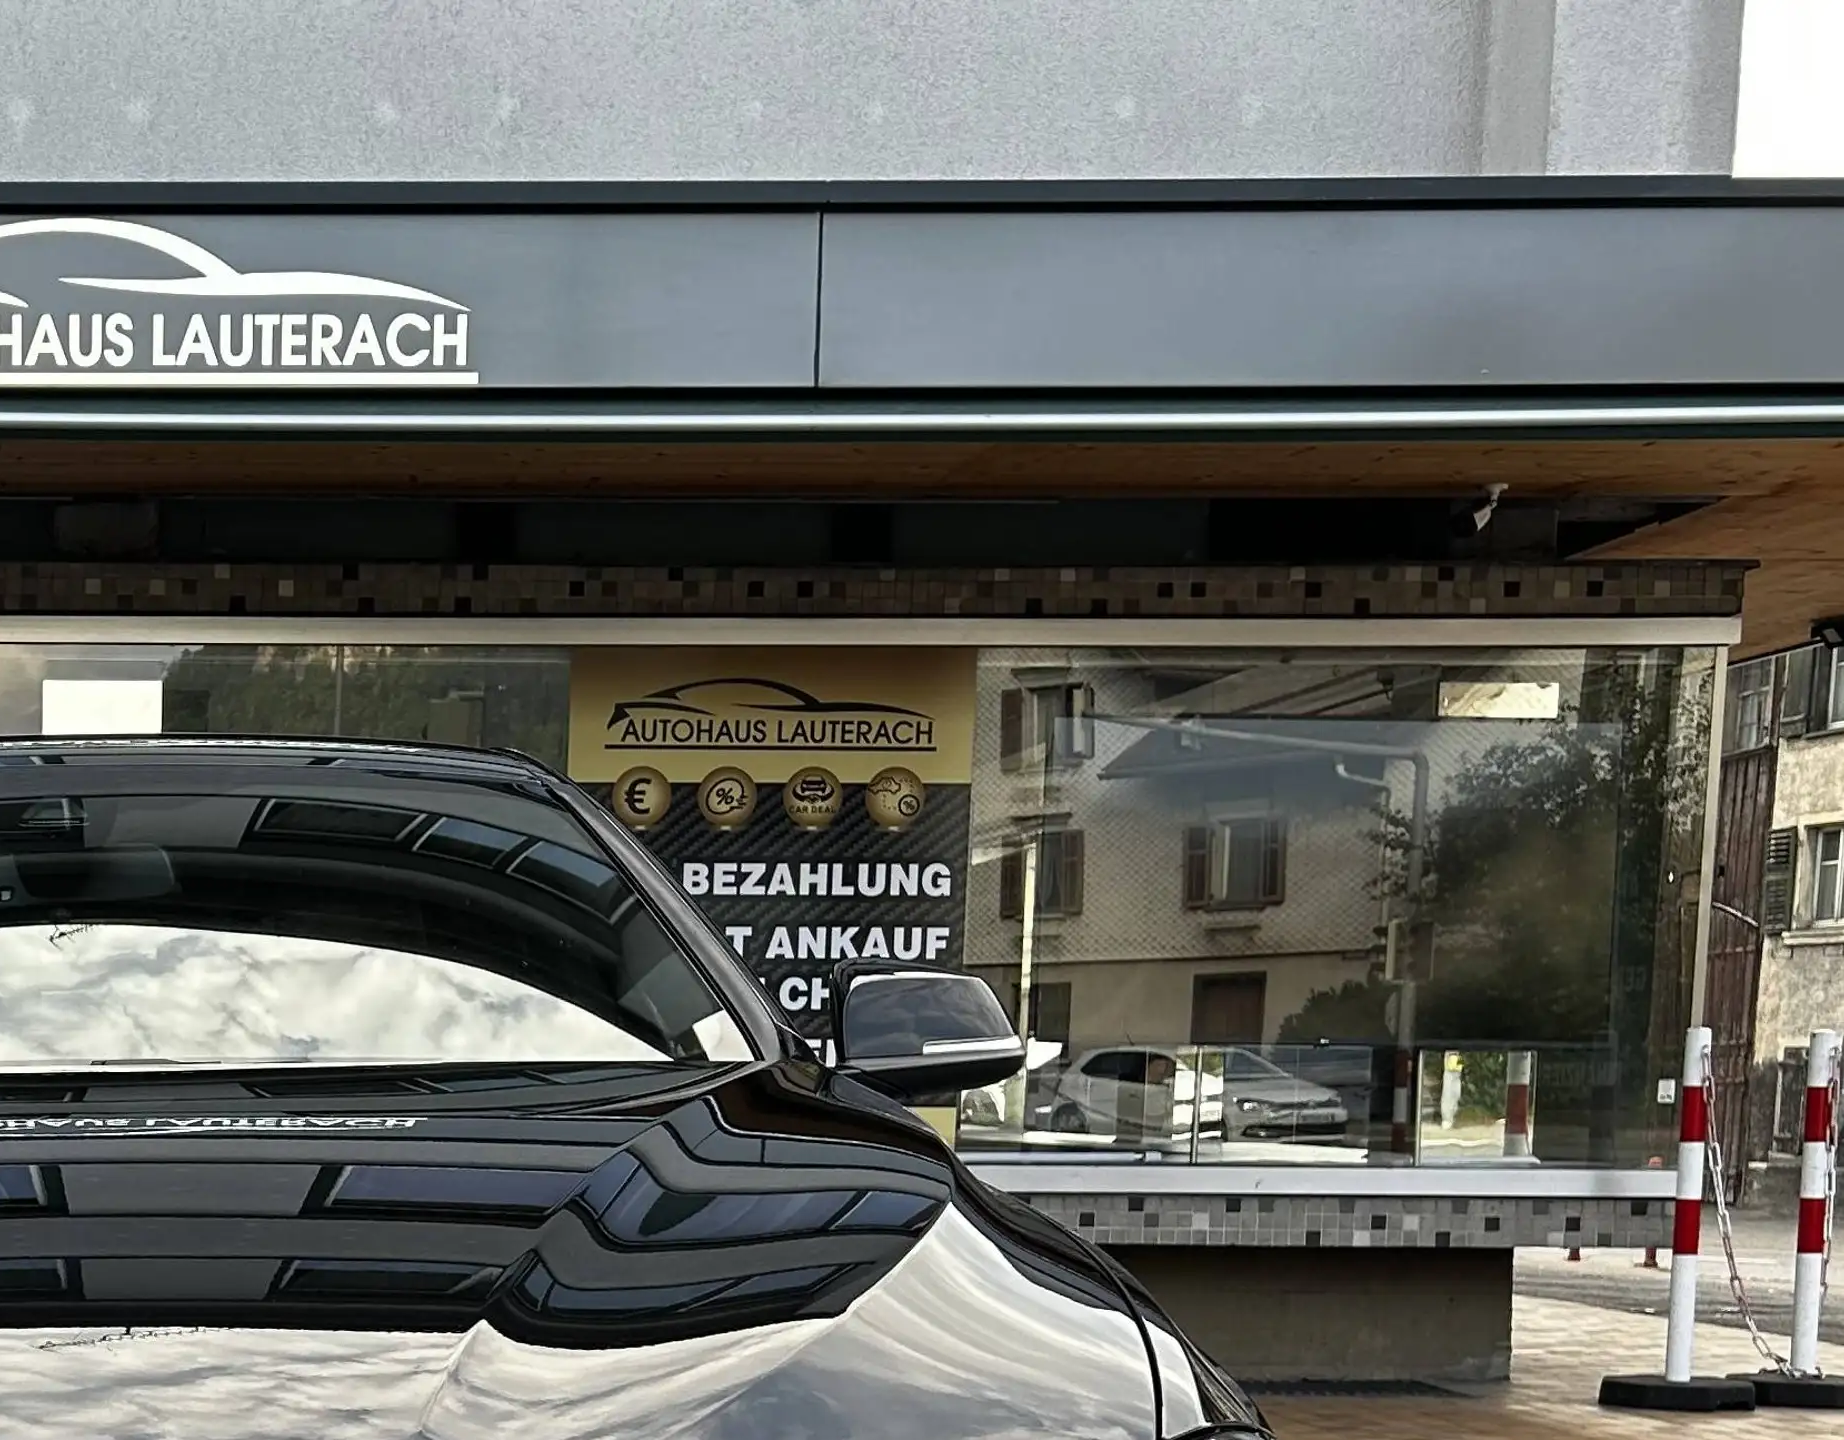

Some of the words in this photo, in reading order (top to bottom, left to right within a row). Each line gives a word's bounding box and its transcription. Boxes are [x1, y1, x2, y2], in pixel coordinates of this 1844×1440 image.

[152, 312, 468, 367] LAUTERACH
[620, 718, 767, 744] AUTOHAUS
[776, 718, 933, 745] LAUTERACH
[789, 806, 808, 815] CAR
[682, 862, 951, 897] BEZAHLUNG
[765, 926, 950, 960] ANKAUF
